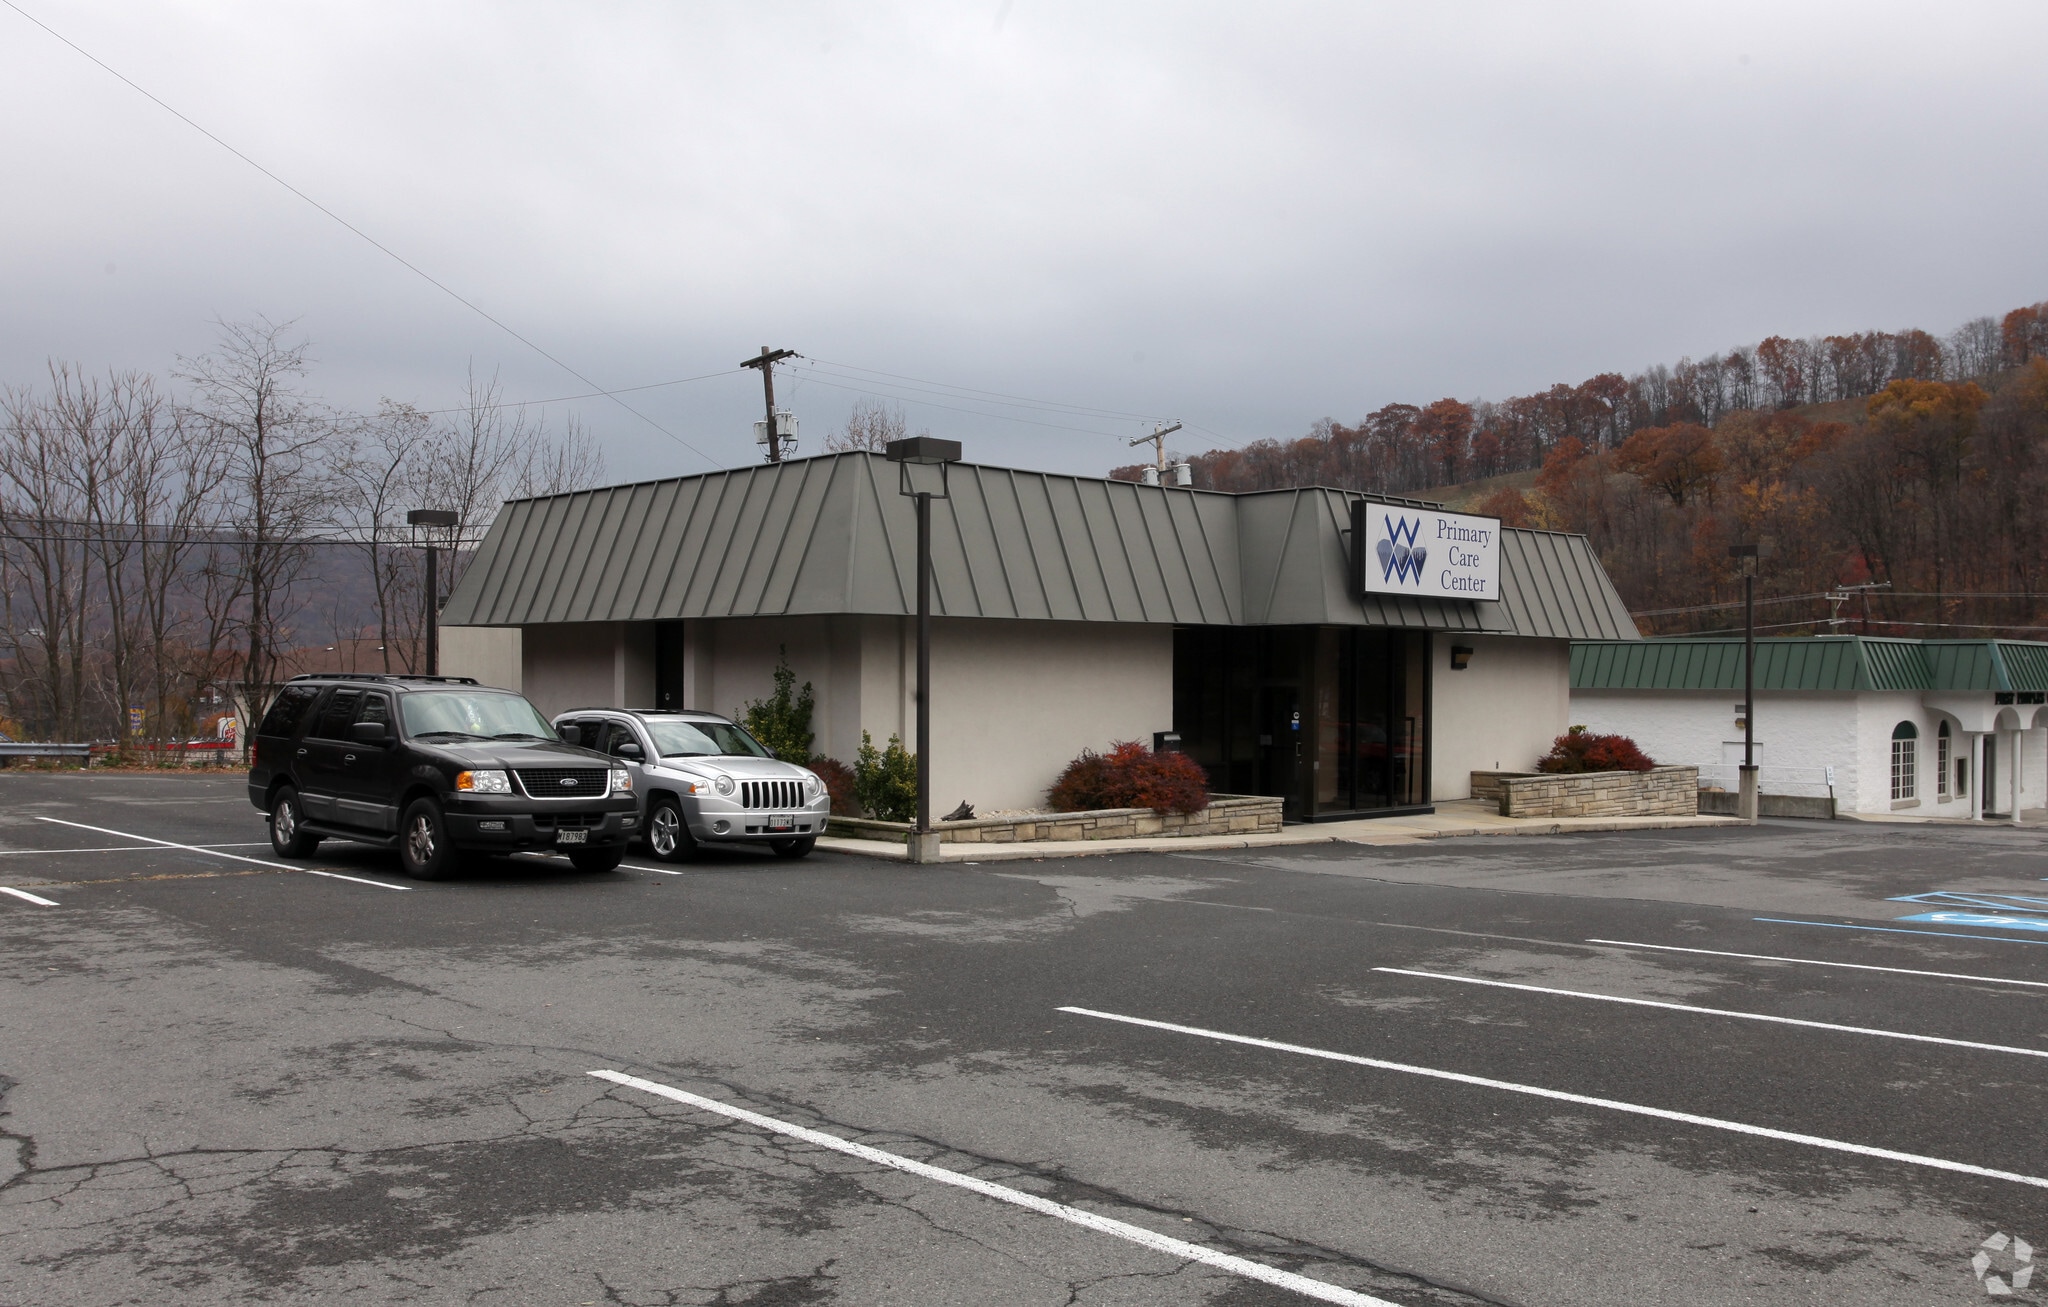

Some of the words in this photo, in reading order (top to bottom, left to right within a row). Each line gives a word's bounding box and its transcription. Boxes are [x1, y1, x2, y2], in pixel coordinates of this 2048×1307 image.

[1437, 518, 1491, 548] Primary
[1449, 546, 1480, 567] Care
[1441, 569, 1486, 592] Center
